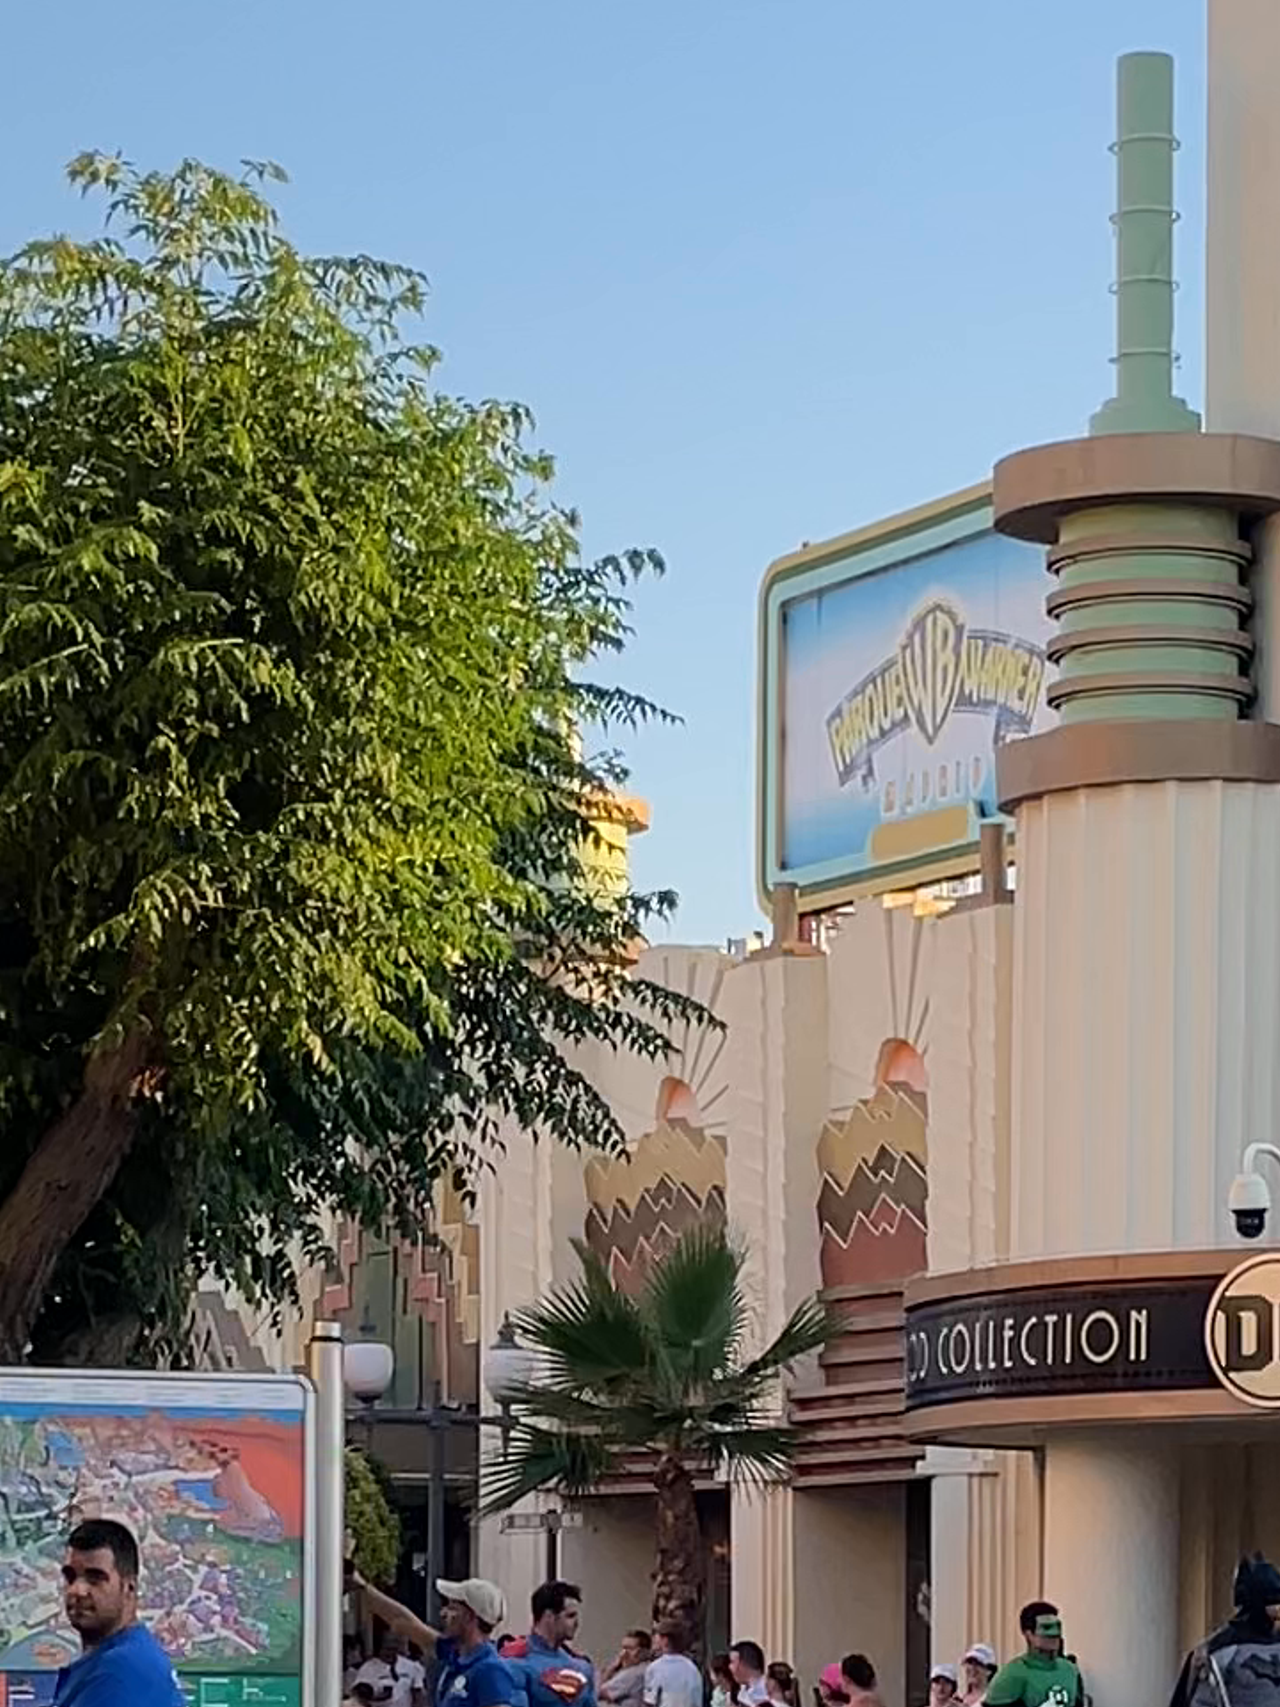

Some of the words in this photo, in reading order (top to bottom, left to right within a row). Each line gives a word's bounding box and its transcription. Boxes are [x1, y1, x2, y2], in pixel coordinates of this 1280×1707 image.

[830, 663, 905, 773] PARQUE
[898, 609, 958, 739] WB
[962, 637, 1042, 721] WARNER
[937, 1308, 1148, 1375] COLLECTION
